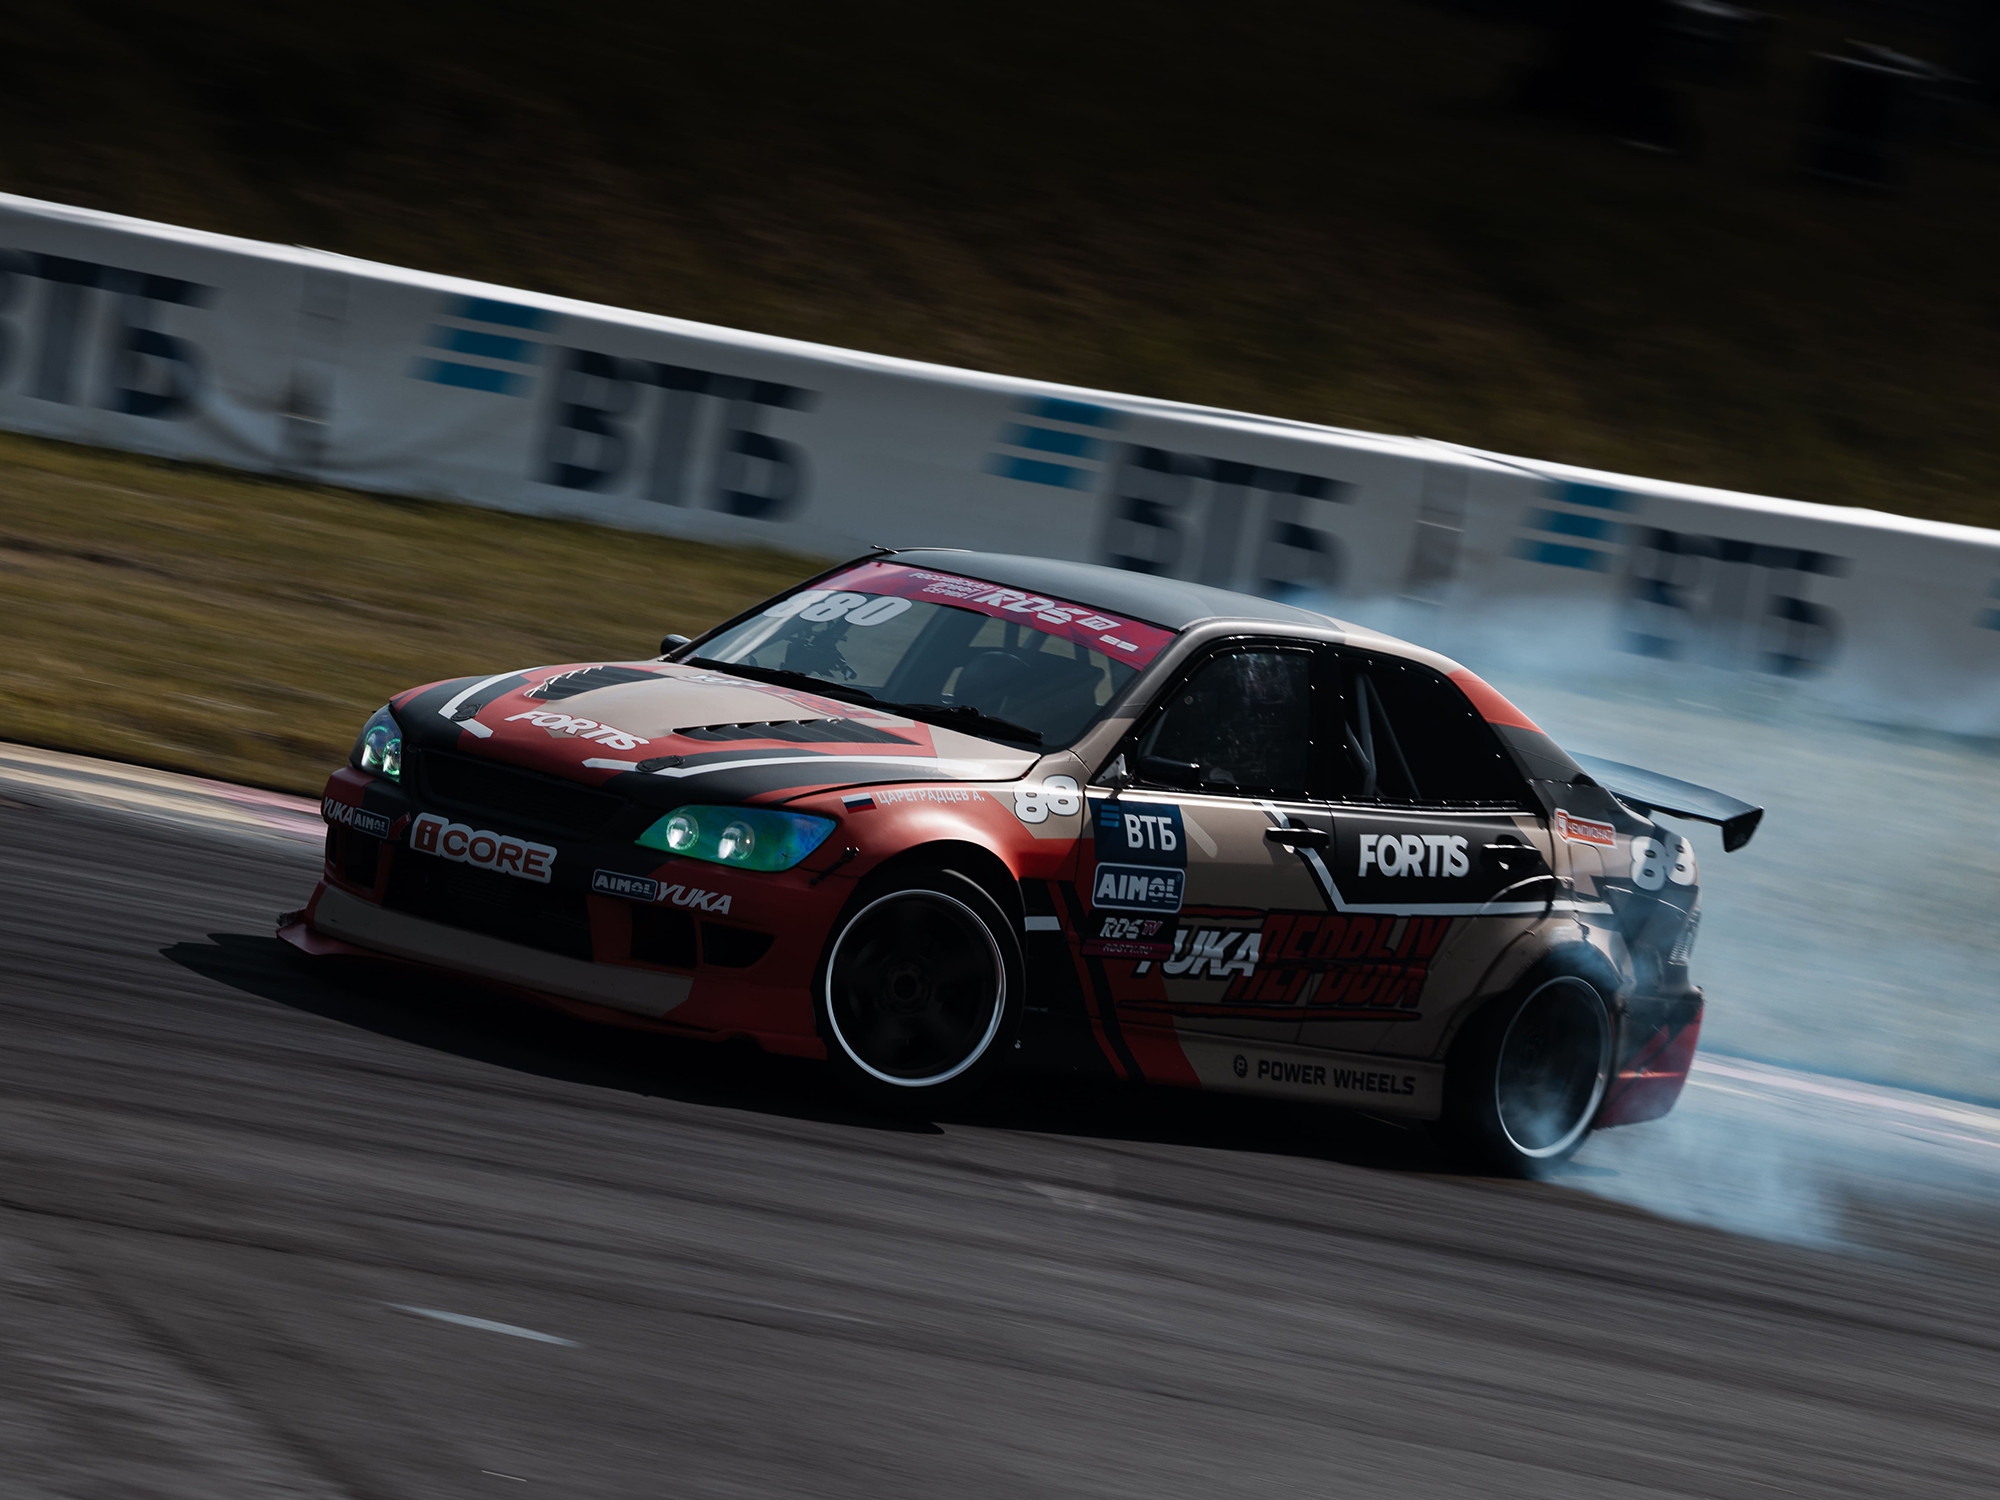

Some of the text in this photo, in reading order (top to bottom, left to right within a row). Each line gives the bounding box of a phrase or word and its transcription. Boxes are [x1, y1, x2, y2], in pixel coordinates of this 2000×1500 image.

[530, 345, 822, 523] ВТБ
[972, 588, 1093, 625] RDS
[504, 710, 650, 751] FORTIS
[323, 797, 353, 829] YUKA
[1013, 774, 1081, 824] 88
[1124, 813, 1178, 852] ВТБ
[1357, 833, 1471, 878] FORTIS
[1630, 835, 1698, 892] 88
[594, 874, 733, 916] AIMOL YUKA
[1096, 873, 1180, 904] AIMOL
[1257, 1059, 1417, 1096] POWER WHEELS
